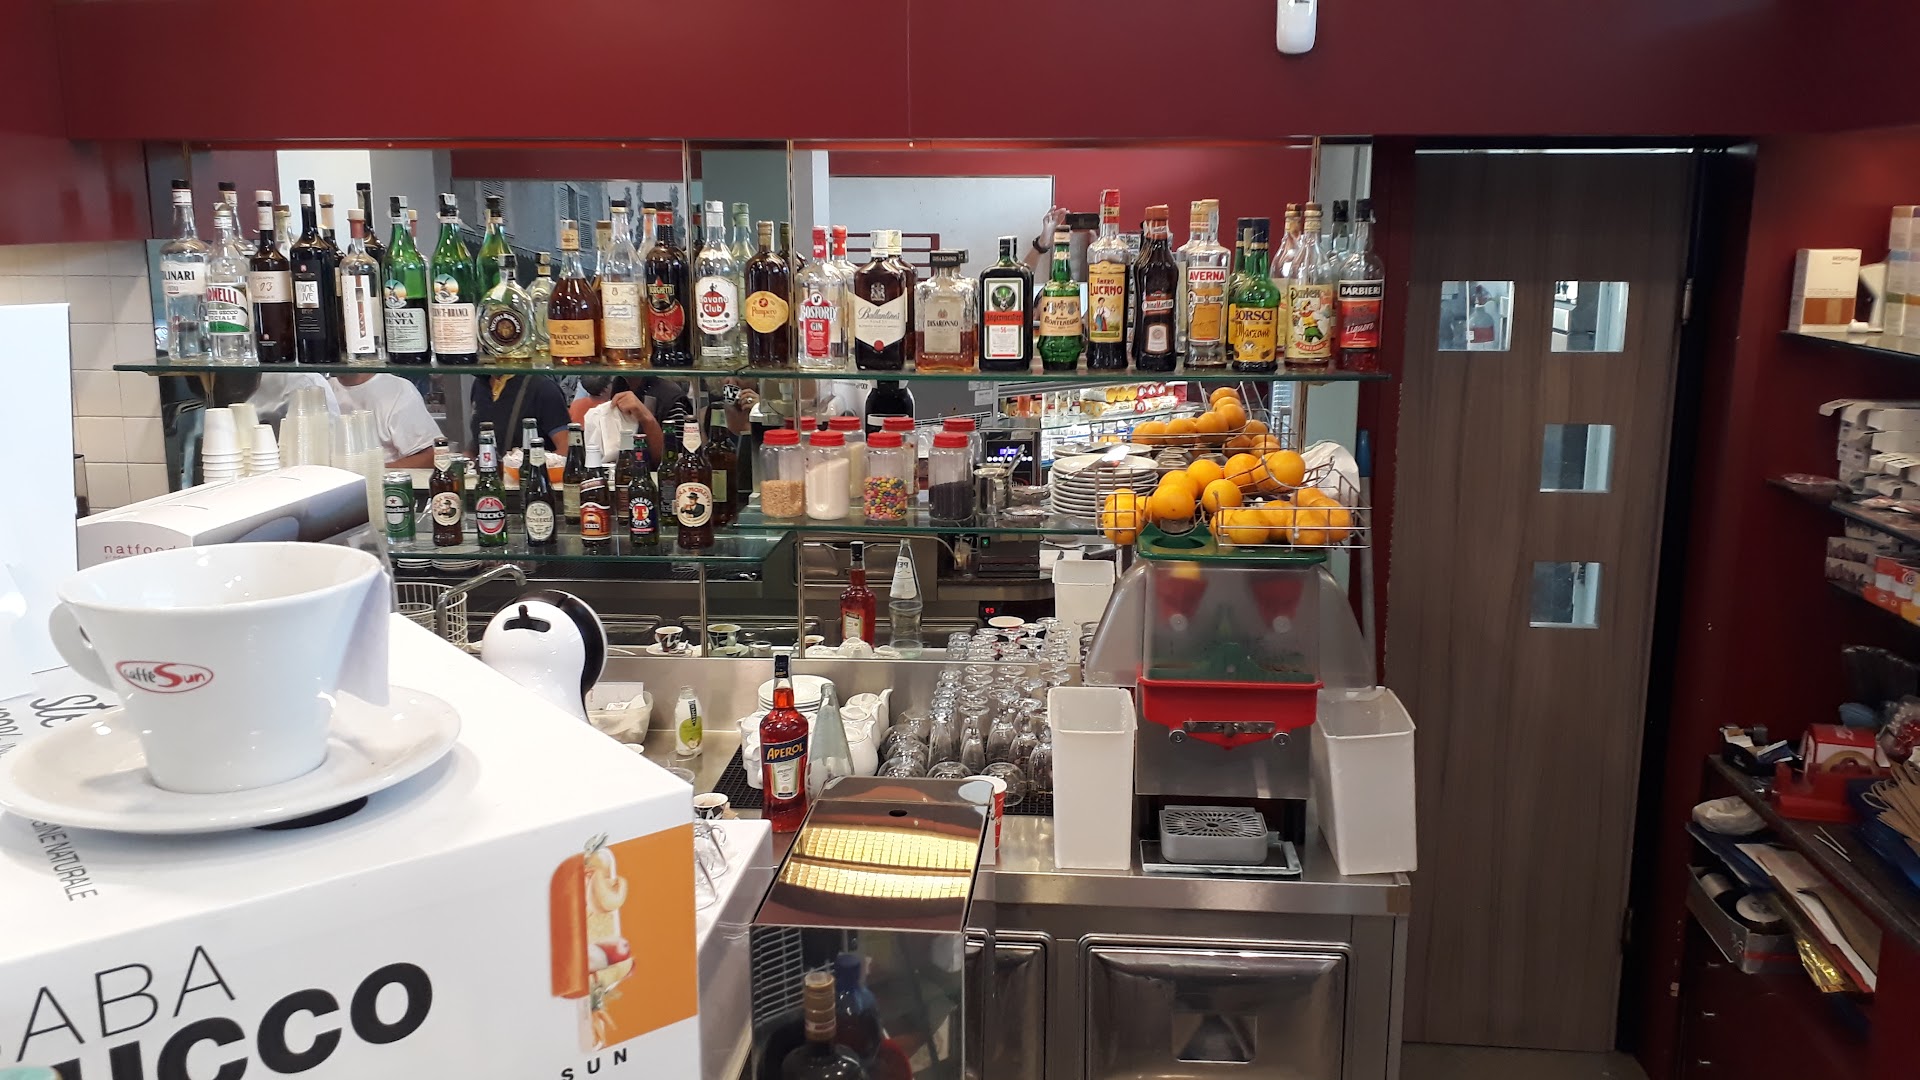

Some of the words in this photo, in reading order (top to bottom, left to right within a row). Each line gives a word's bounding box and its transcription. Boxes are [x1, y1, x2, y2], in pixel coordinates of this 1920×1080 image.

[1189, 271, 1225, 281] AVERNA
[1090, 283, 1123, 296] LUCANO
[1341, 286, 1381, 295] BARBIERI
[703, 304, 723, 312] Club
[751, 306, 777, 318] Pampero
[857, 306, 900, 320] Ballantine's
[810, 323, 823, 331] GIN
[476, 511, 505, 519] BECK'S
[766, 742, 804, 761] APEROL
[43, 842, 99, 902] NATURALE
[53, 962, 433, 1080] UCCO
